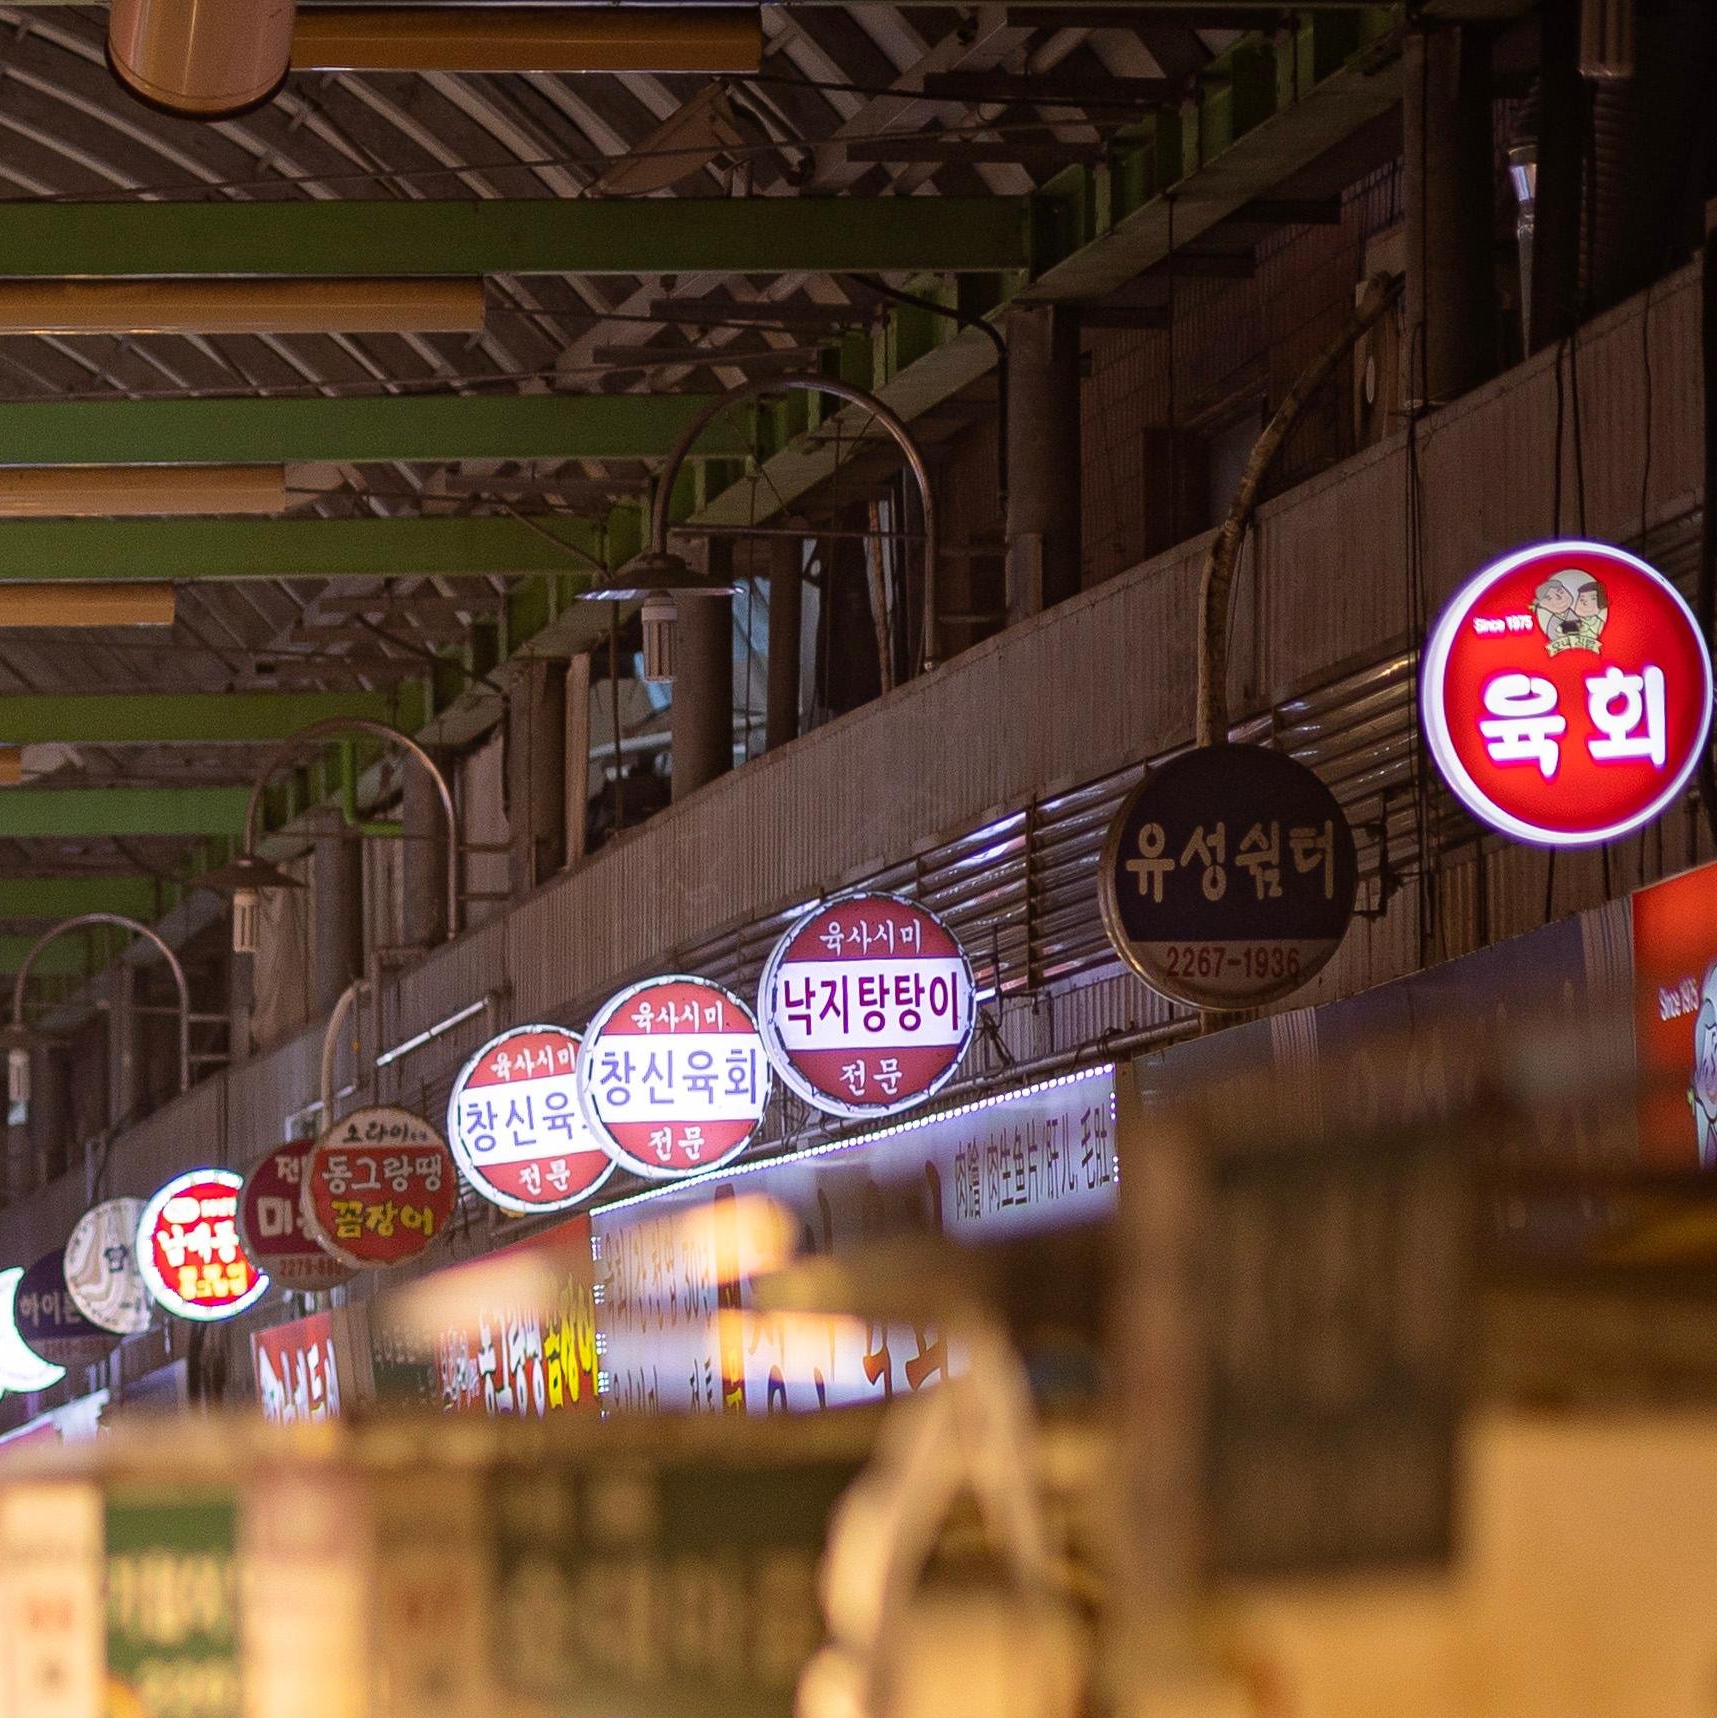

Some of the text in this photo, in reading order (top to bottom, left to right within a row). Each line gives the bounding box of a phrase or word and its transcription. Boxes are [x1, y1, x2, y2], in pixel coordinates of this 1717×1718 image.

[1479, 664, 1668, 780] 육회
[1125, 819, 1336, 904] 유성쉼터
[818, 918, 923, 956] 육사시미
[1166, 946, 1302, 981] 2267-1936
[630, 1002, 725, 1037] 육사시미
[783, 972, 961, 1037] 낙지탕탕이
[598, 1048, 760, 1107] 창신육회
[839, 1056, 904, 1098] 전문
[464, 1093, 591, 1153] 창신육
[647, 1125, 706, 1162] 전문
[321, 1153, 443, 1196] 동그랑땡
[518, 1158, 572, 1195] 전문
